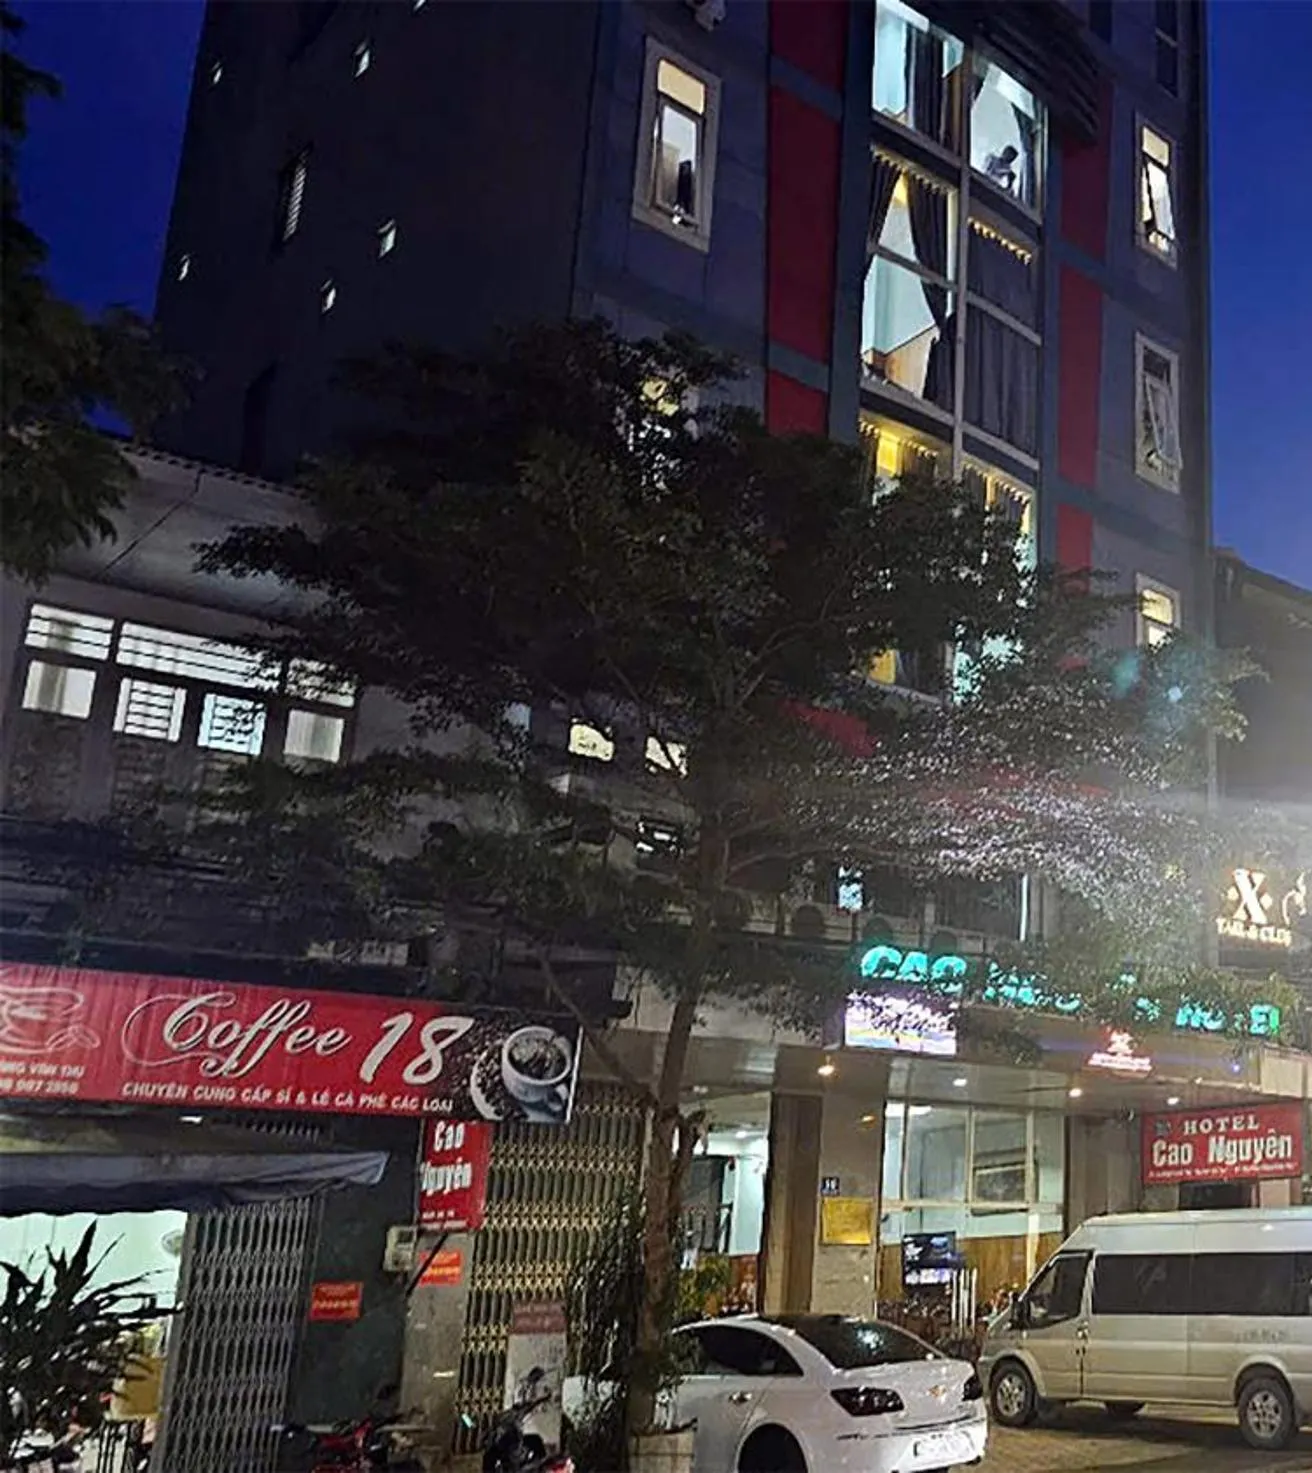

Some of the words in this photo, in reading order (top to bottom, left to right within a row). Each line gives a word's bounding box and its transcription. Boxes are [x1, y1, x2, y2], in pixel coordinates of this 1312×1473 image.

[122, 991, 352, 1078] Coffee
[359, 1012, 475, 1085] 18
[433, 1120, 466, 1152] Cao
[1183, 1113, 1260, 1136] HOTEL
[1152, 1139, 1193, 1167] Cao
[1207, 1128, 1293, 1167] Nguyên
